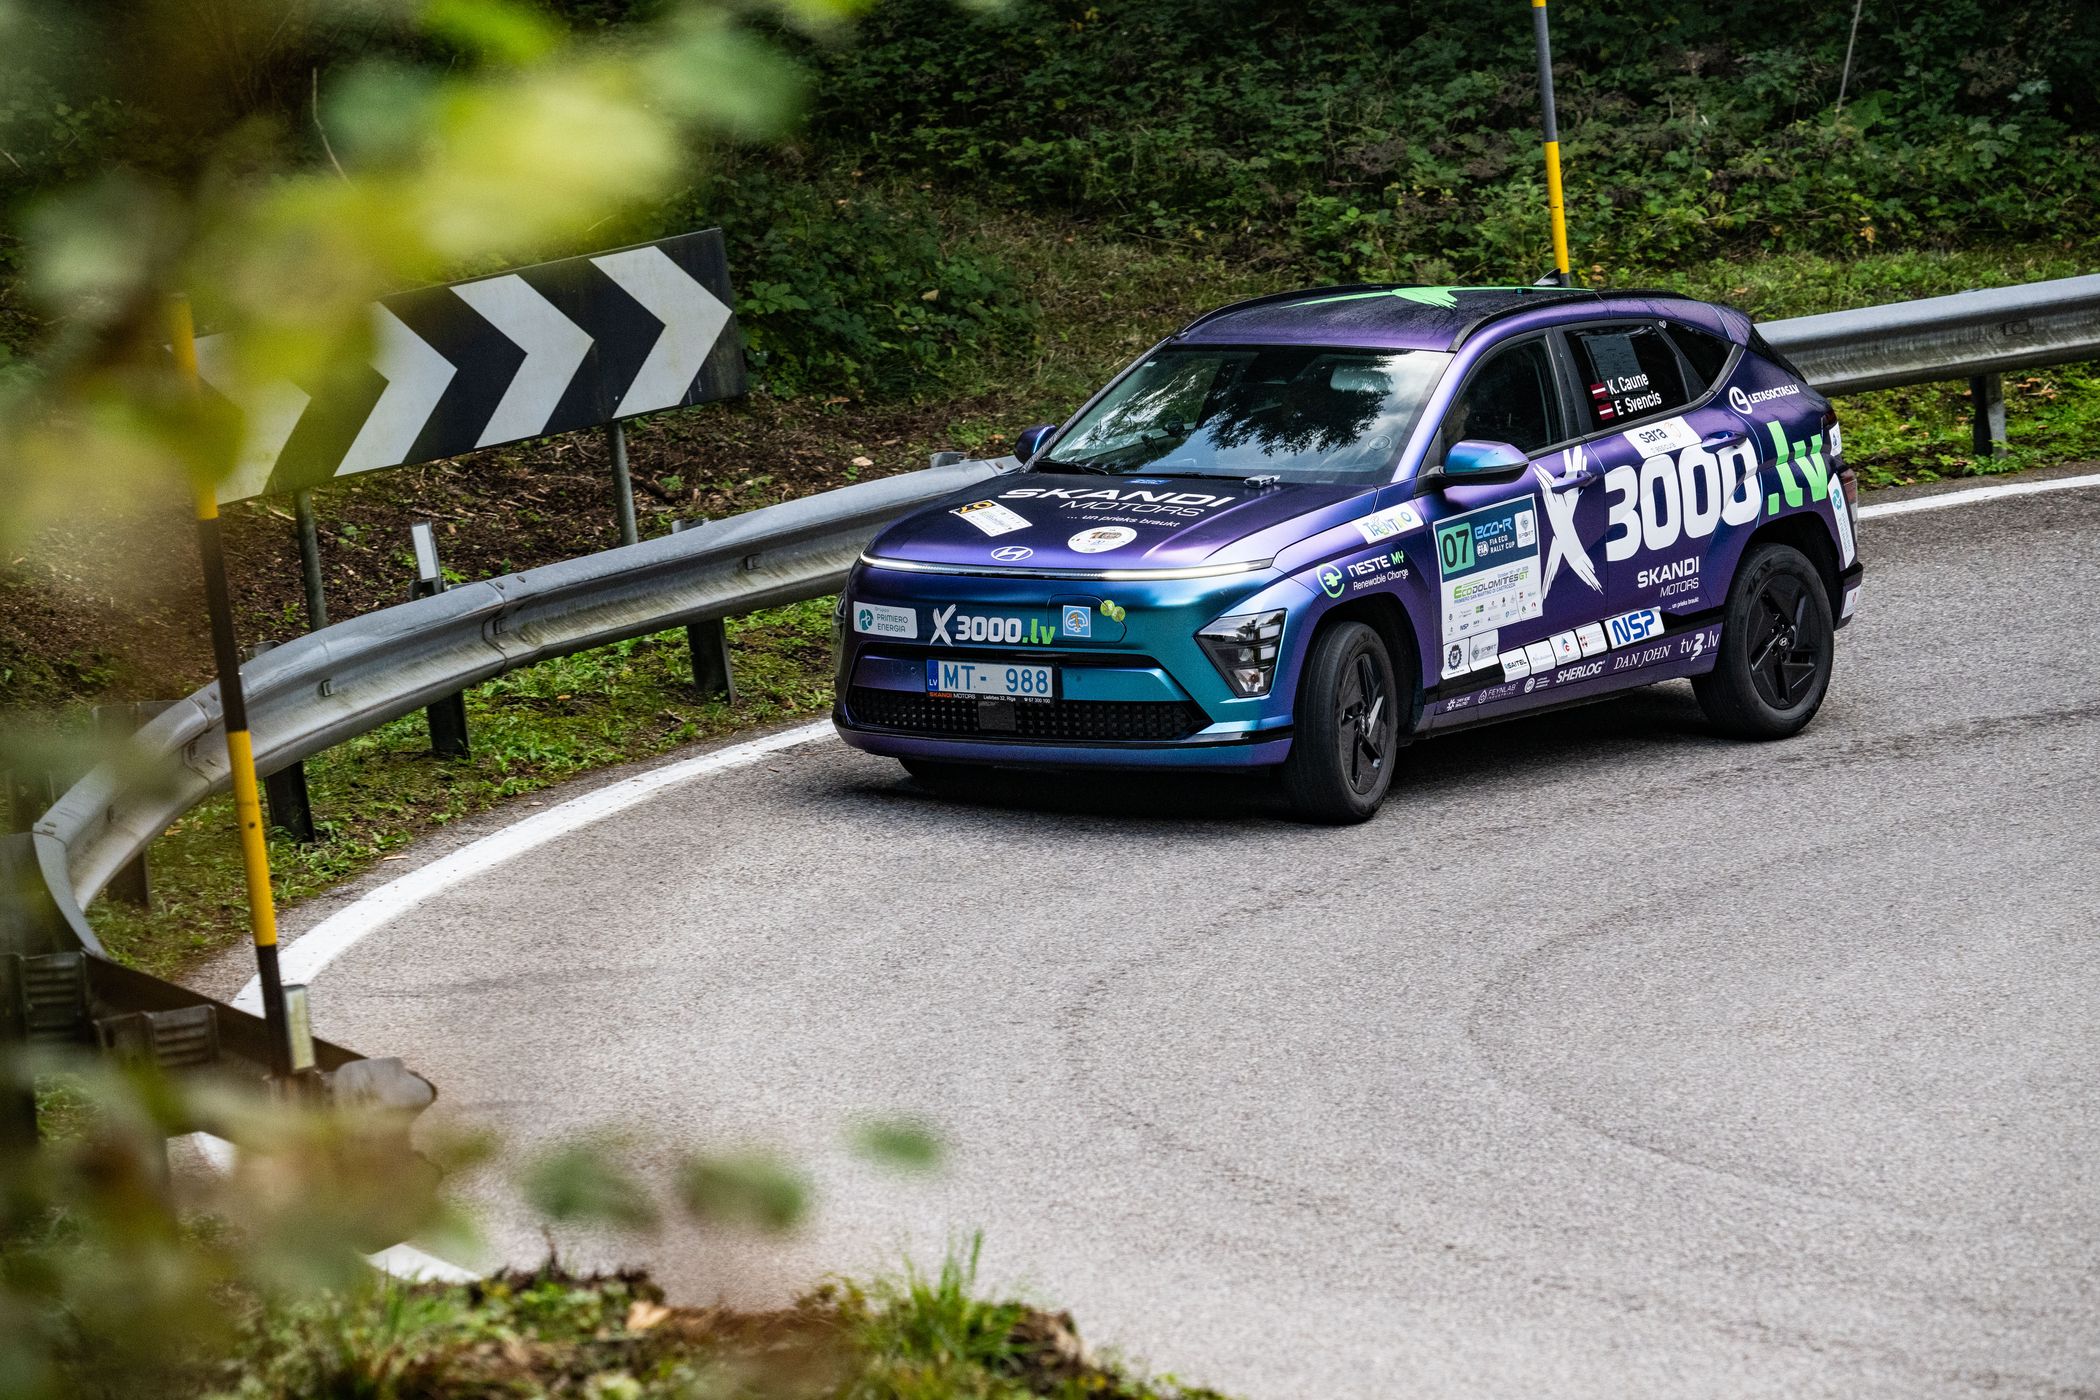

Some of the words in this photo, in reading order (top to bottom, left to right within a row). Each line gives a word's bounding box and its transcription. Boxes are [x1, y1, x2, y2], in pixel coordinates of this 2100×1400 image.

[1606, 379, 1620, 395] K.
[1617, 373, 1649, 392] Caune
[1624, 390, 1662, 413] Svencis
[1638, 426, 1667, 444] sara
[997, 488, 1236, 508] SKANDI
[1059, 500, 1205, 518] MOTORS
[1097, 514, 1139, 524] prieks
[1141, 517, 1181, 528] braukt
[1442, 528, 1470, 568] 07
[1489, 537, 1498, 546] FIA
[1498, 534, 1509, 543] ECO
[1489, 543, 1505, 554] RALLY
[1505, 540, 1516, 550] CUP
[1347, 554, 1391, 578] NESTE
[1390, 550, 1405, 565] MY
[1636, 556, 1700, 589] SKANDI
[1353, 572, 1387, 590] Renewable
[1387, 568, 1409, 581] Charge
[1659, 577, 1700, 598] MOTORS
[876, 613, 909, 624] PRIMIERO
[877, 623, 906, 633] ENERGIA
[1611, 609, 1655, 645] NSP
[1614, 655, 1638, 670] DAN
[1638, 645, 1672, 667] JOHN
[928, 678, 938, 687] LV
[1005, 667, 1048, 694] 988
[1555, 661, 1602, 683] SHERLOG
[928, 691, 953, 699] SKANDI
